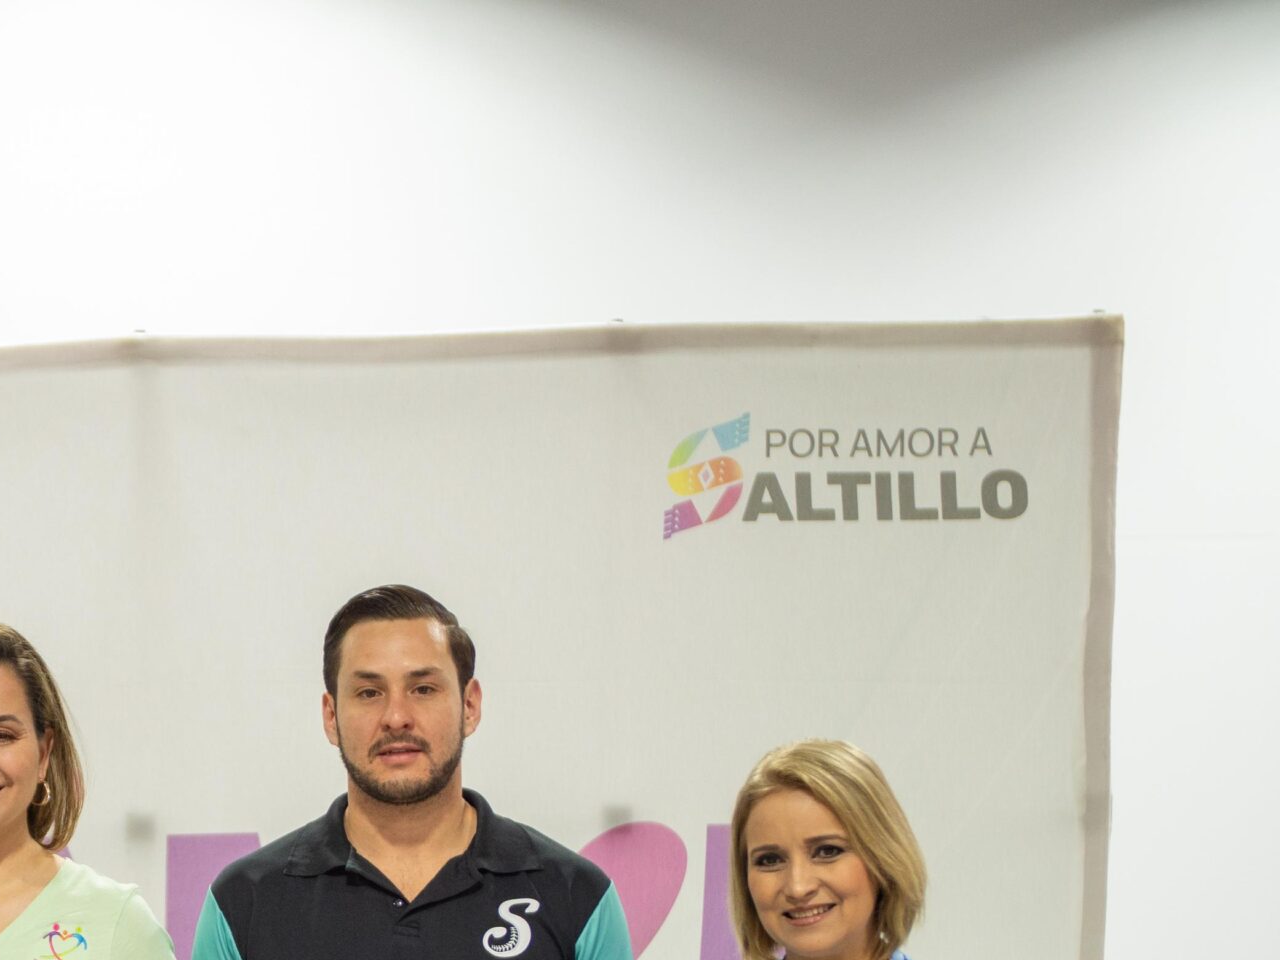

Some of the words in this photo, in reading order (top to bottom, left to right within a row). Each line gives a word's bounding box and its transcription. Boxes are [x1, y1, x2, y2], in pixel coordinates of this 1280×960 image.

[765, 428, 840, 458] POR
[849, 426, 960, 458] AMOR
[969, 426, 993, 457] A
